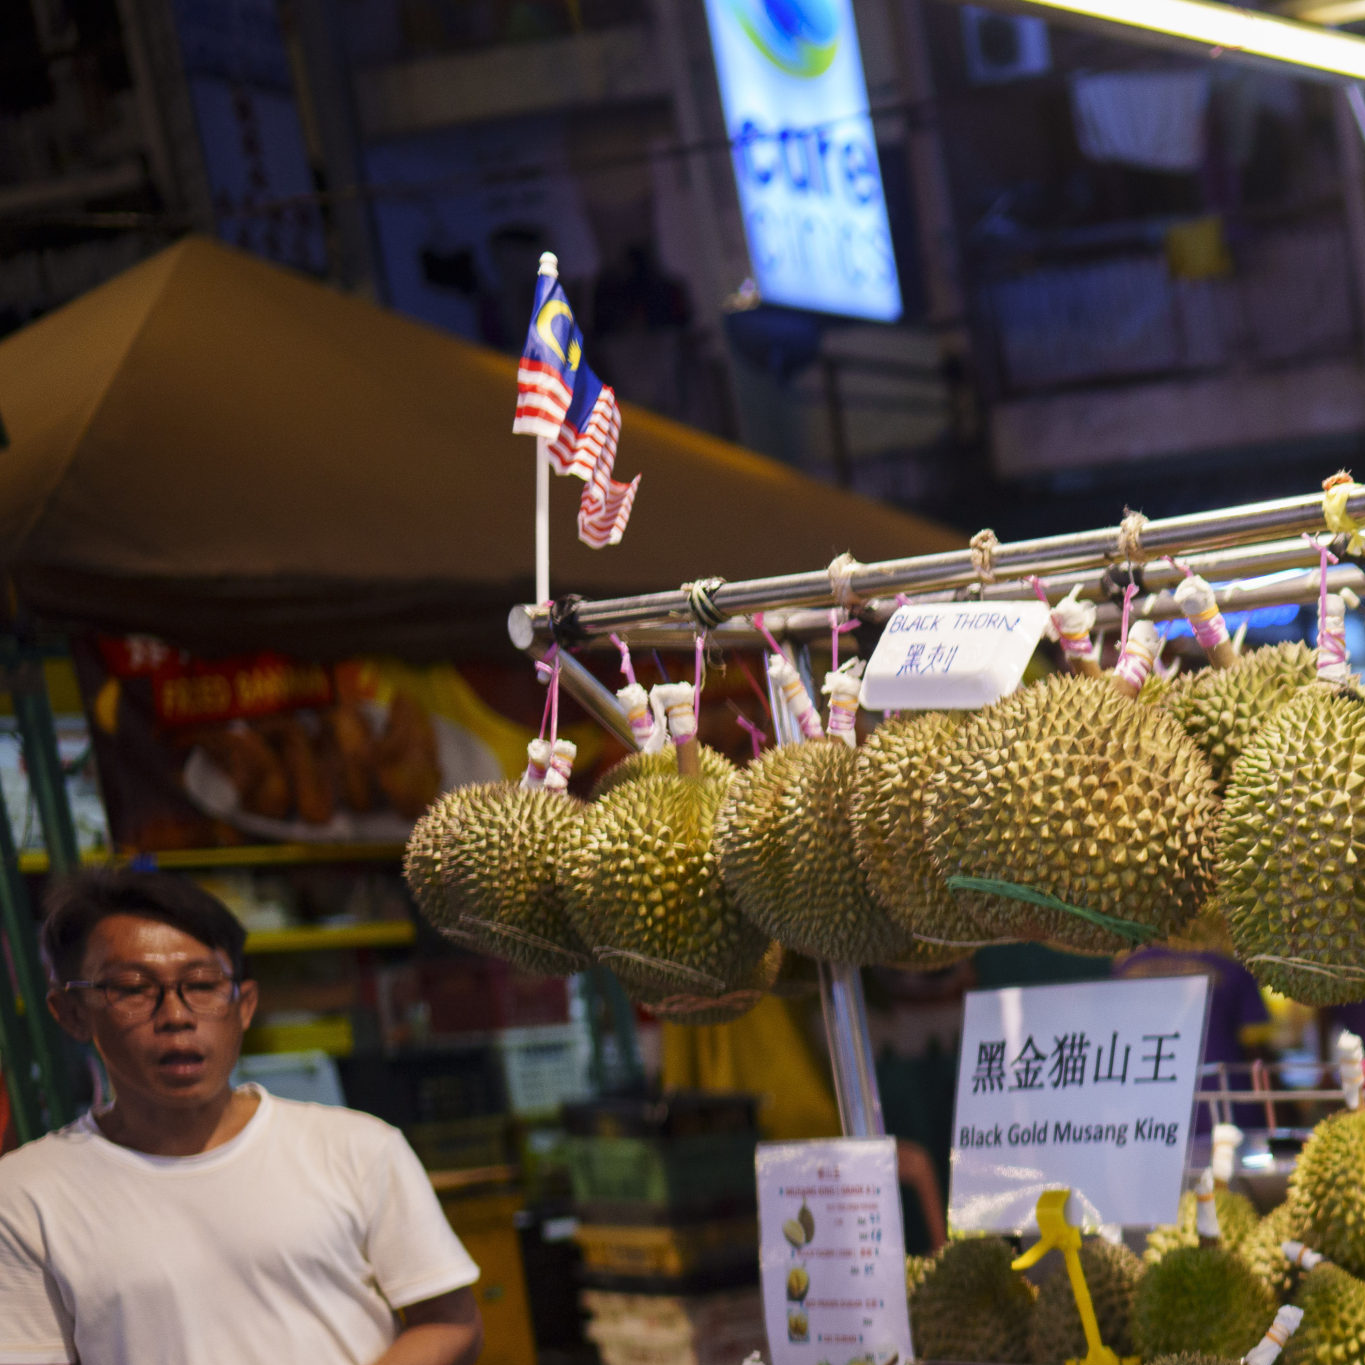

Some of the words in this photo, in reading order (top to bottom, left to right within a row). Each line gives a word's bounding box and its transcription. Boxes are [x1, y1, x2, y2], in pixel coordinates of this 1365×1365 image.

[889, 613, 944, 634] BLACK
[953, 613, 1020, 632] THORN
[972, 1030, 1181, 1093] 黑金猫山王
[959, 1122, 1002, 1148] Black
[1007, 1120, 1048, 1146] Gold
[1053, 1120, 1129, 1147] Musang
[1134, 1115, 1180, 1147] King
